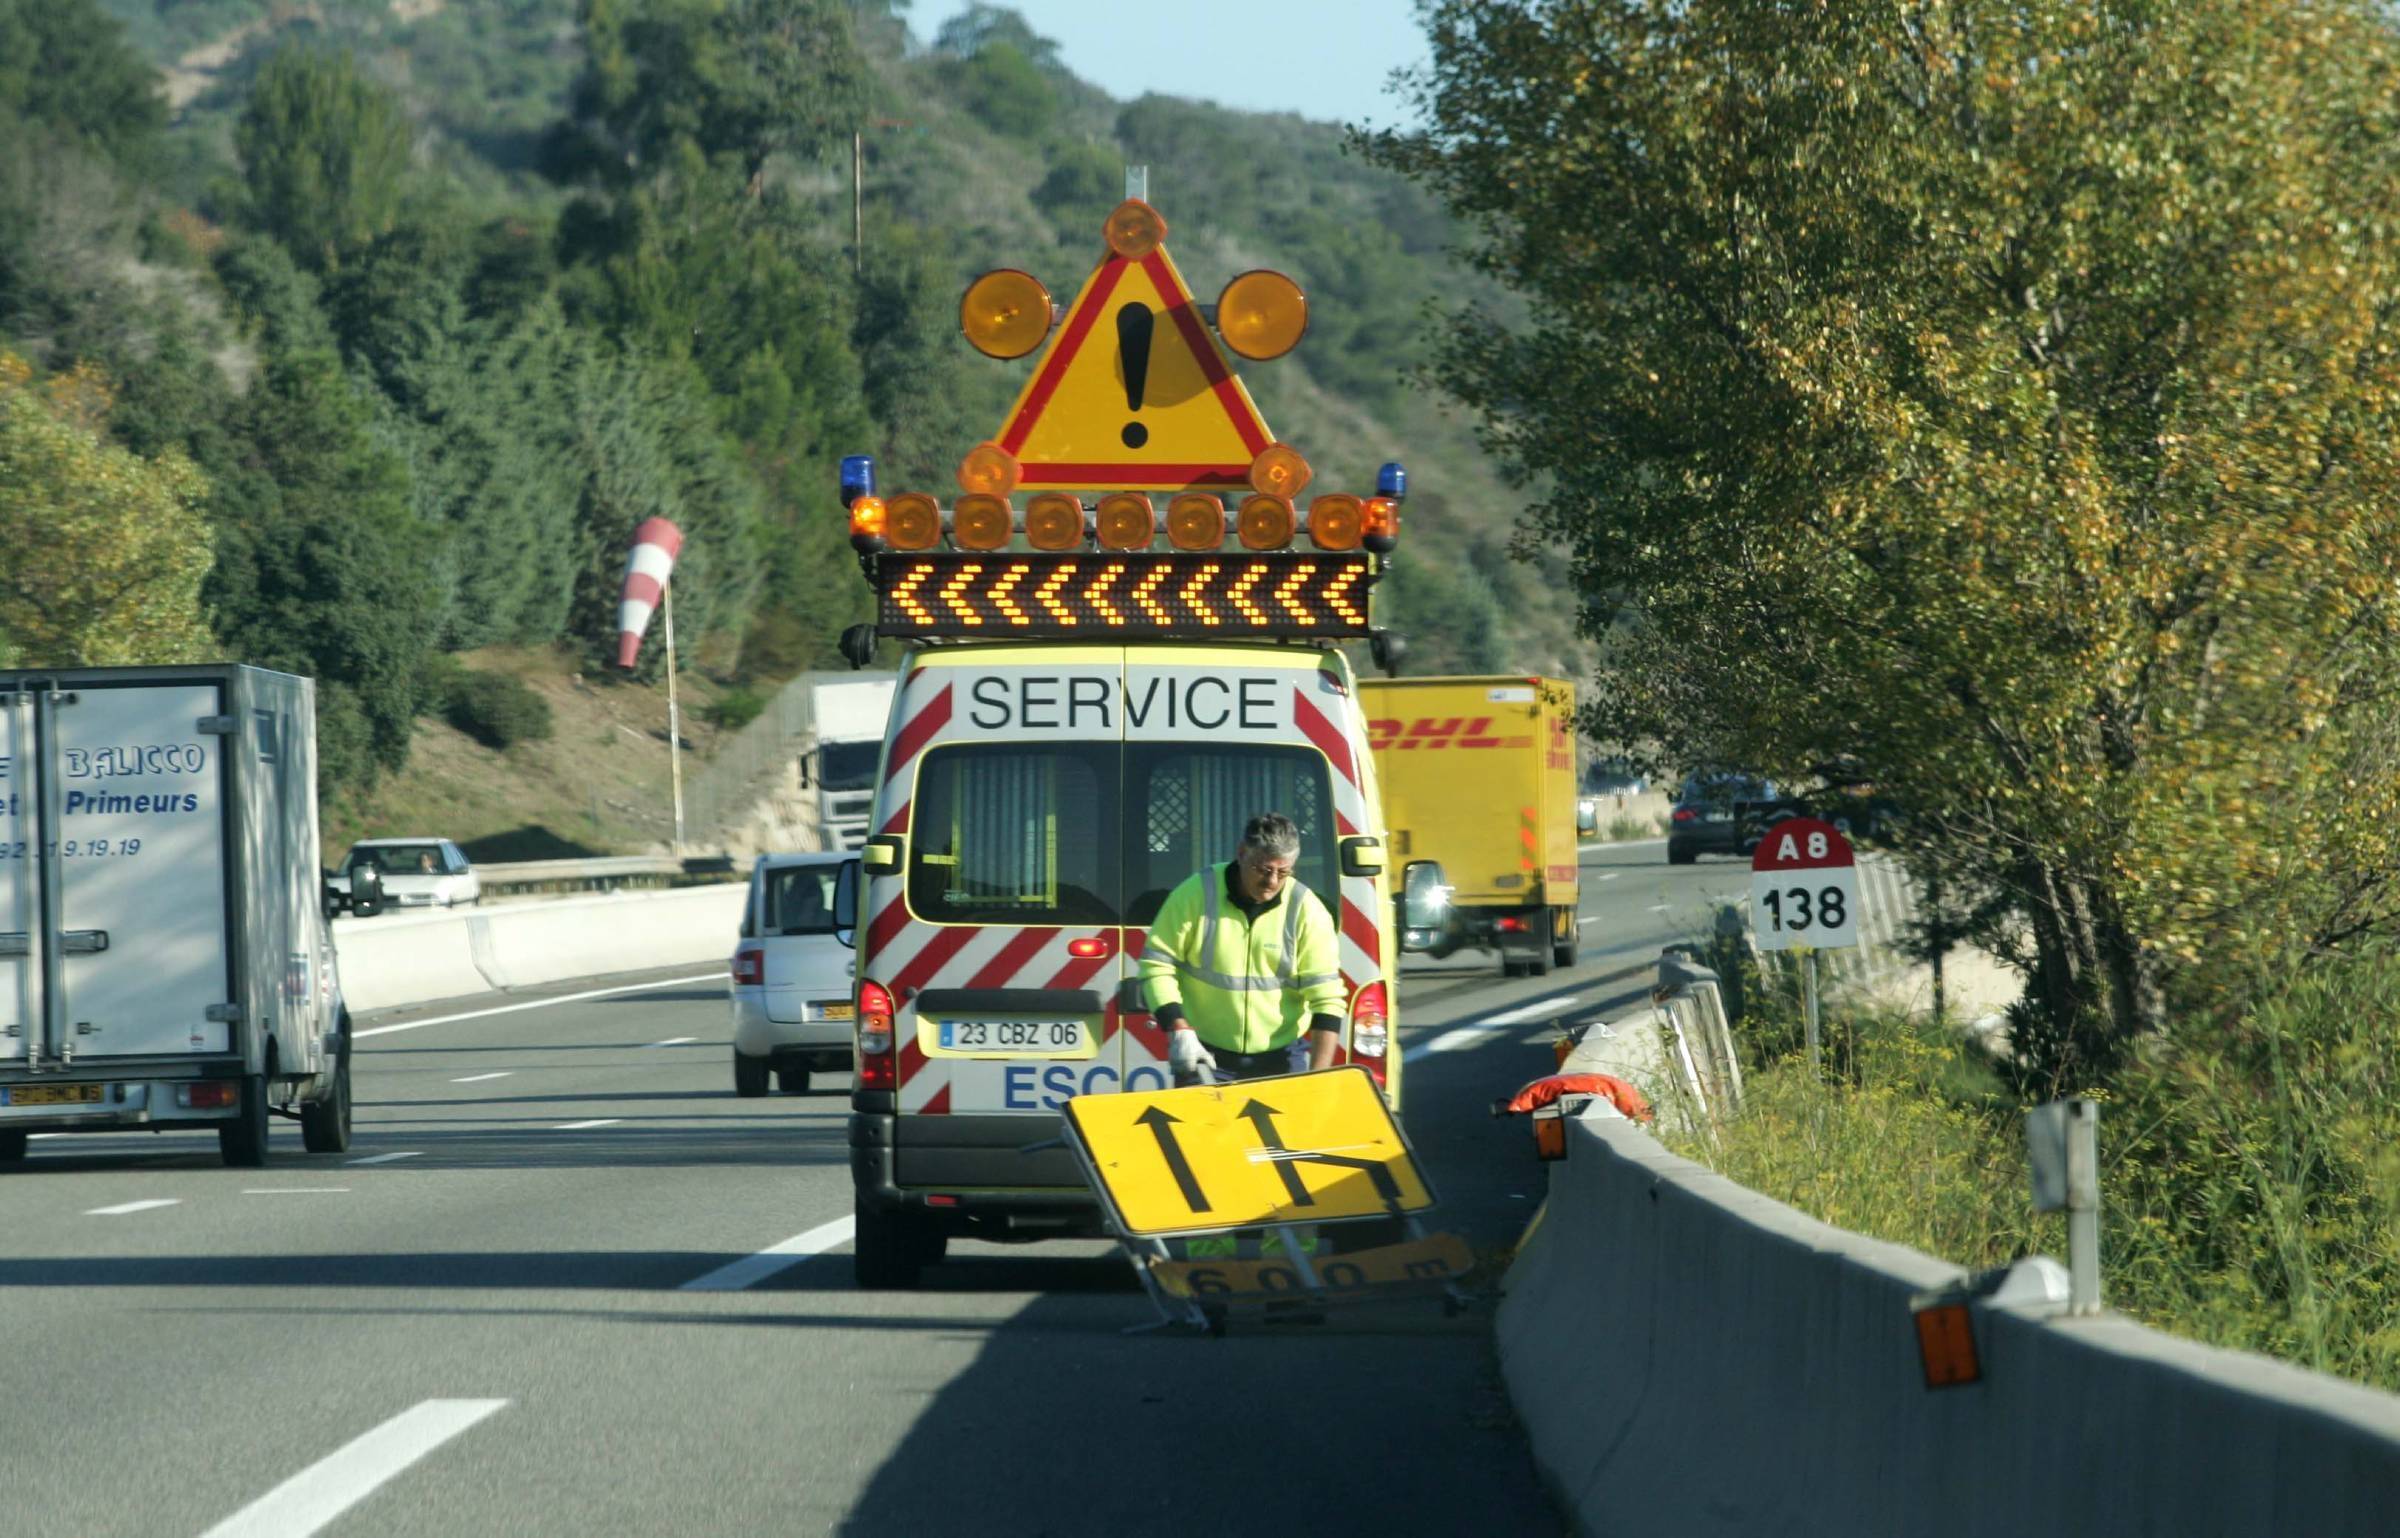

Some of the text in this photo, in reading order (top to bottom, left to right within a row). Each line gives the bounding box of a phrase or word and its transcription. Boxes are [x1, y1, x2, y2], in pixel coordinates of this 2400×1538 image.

[969, 676, 1278, 729] SERVICE
[1366, 717, 1504, 750] DHL
[65, 743, 205, 779] BALICCO
[65, 790, 198, 815] Primeurs
[1762, 886, 1846, 932] 138
[960, 1023, 1077, 1045] 23 CBZ 06
[1187, 1262, 1364, 1296] 600
